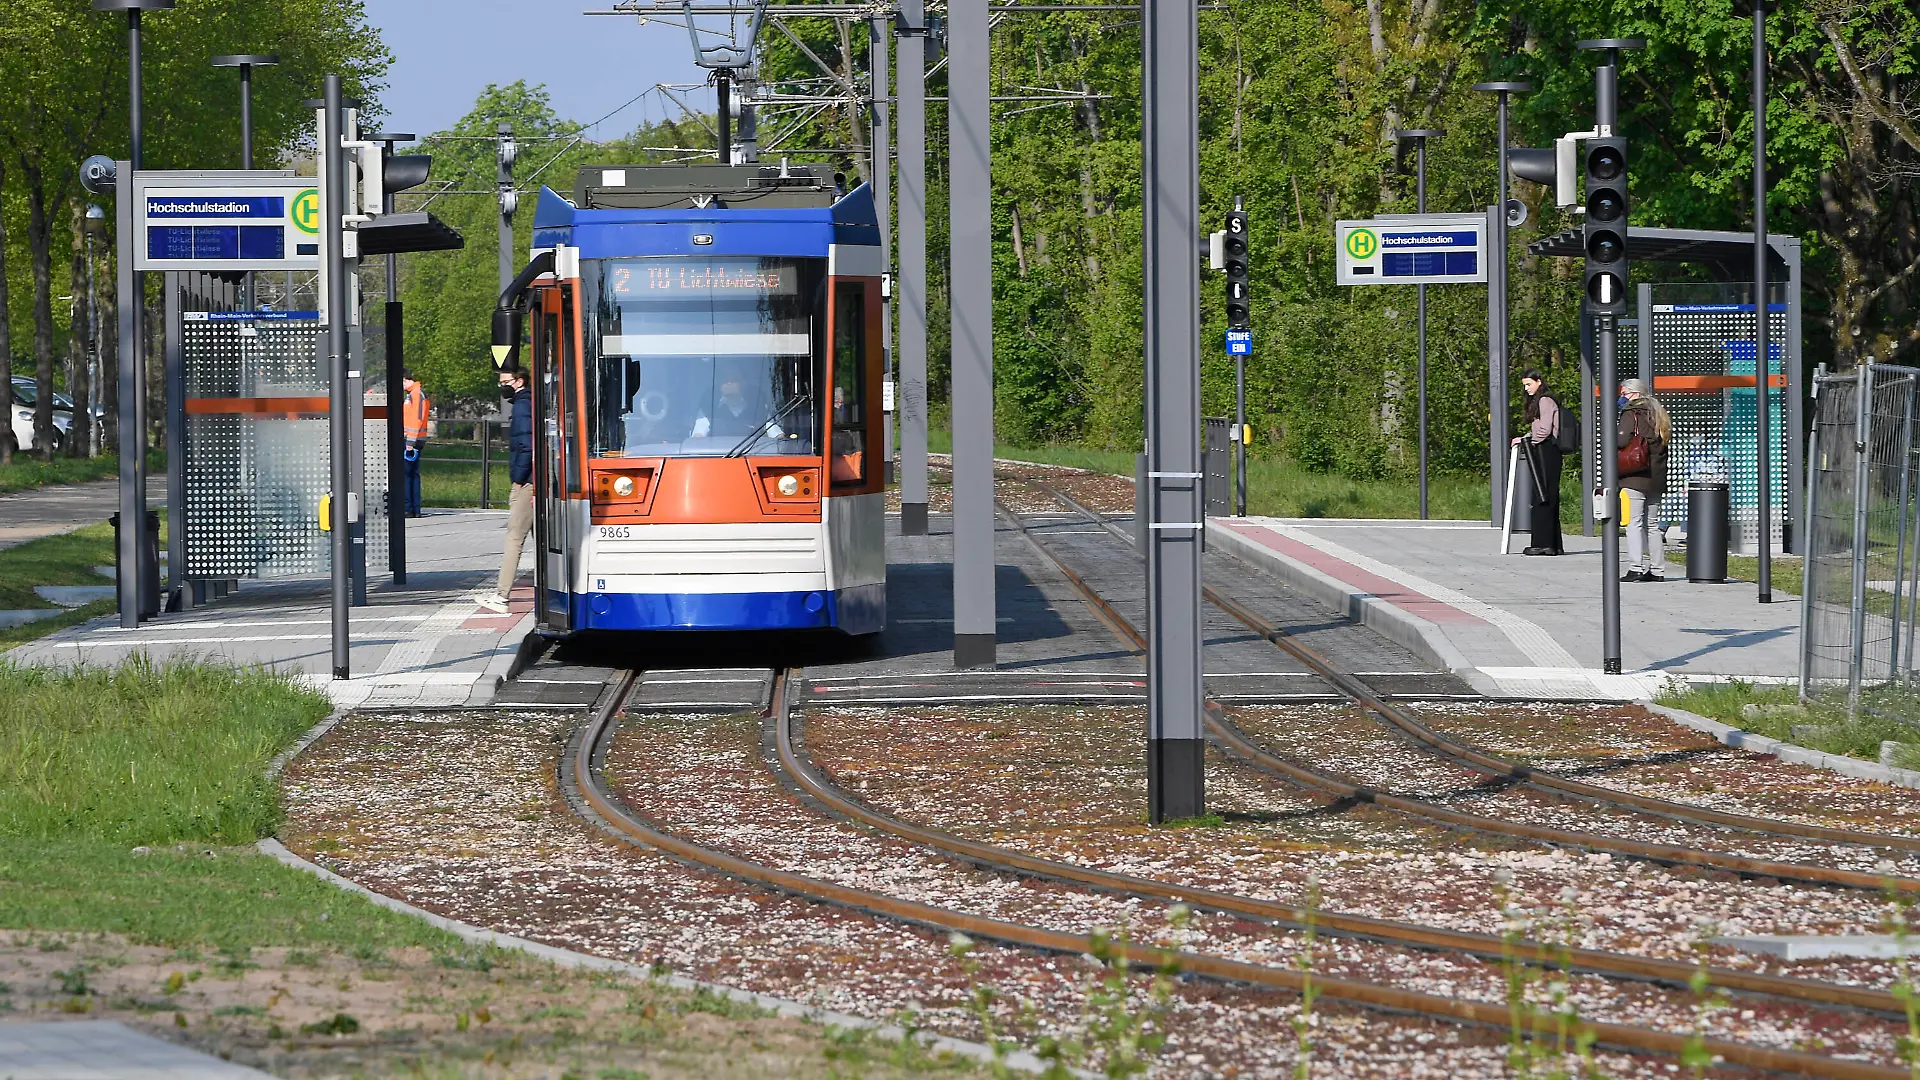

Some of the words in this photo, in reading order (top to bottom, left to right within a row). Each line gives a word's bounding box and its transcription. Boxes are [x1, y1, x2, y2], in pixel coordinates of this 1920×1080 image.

[147, 201, 250, 213] Hochschulstadion
[1231, 218, 1241, 233] S
[1354, 235, 1369, 253] H
[1382, 235, 1453, 245] Hochschulstadion
[615, 268, 631, 292] 2
[1227, 332, 1250, 341] STUFE
[1231, 343, 1246, 353] EIN
[600, 526, 630, 538] 9865
